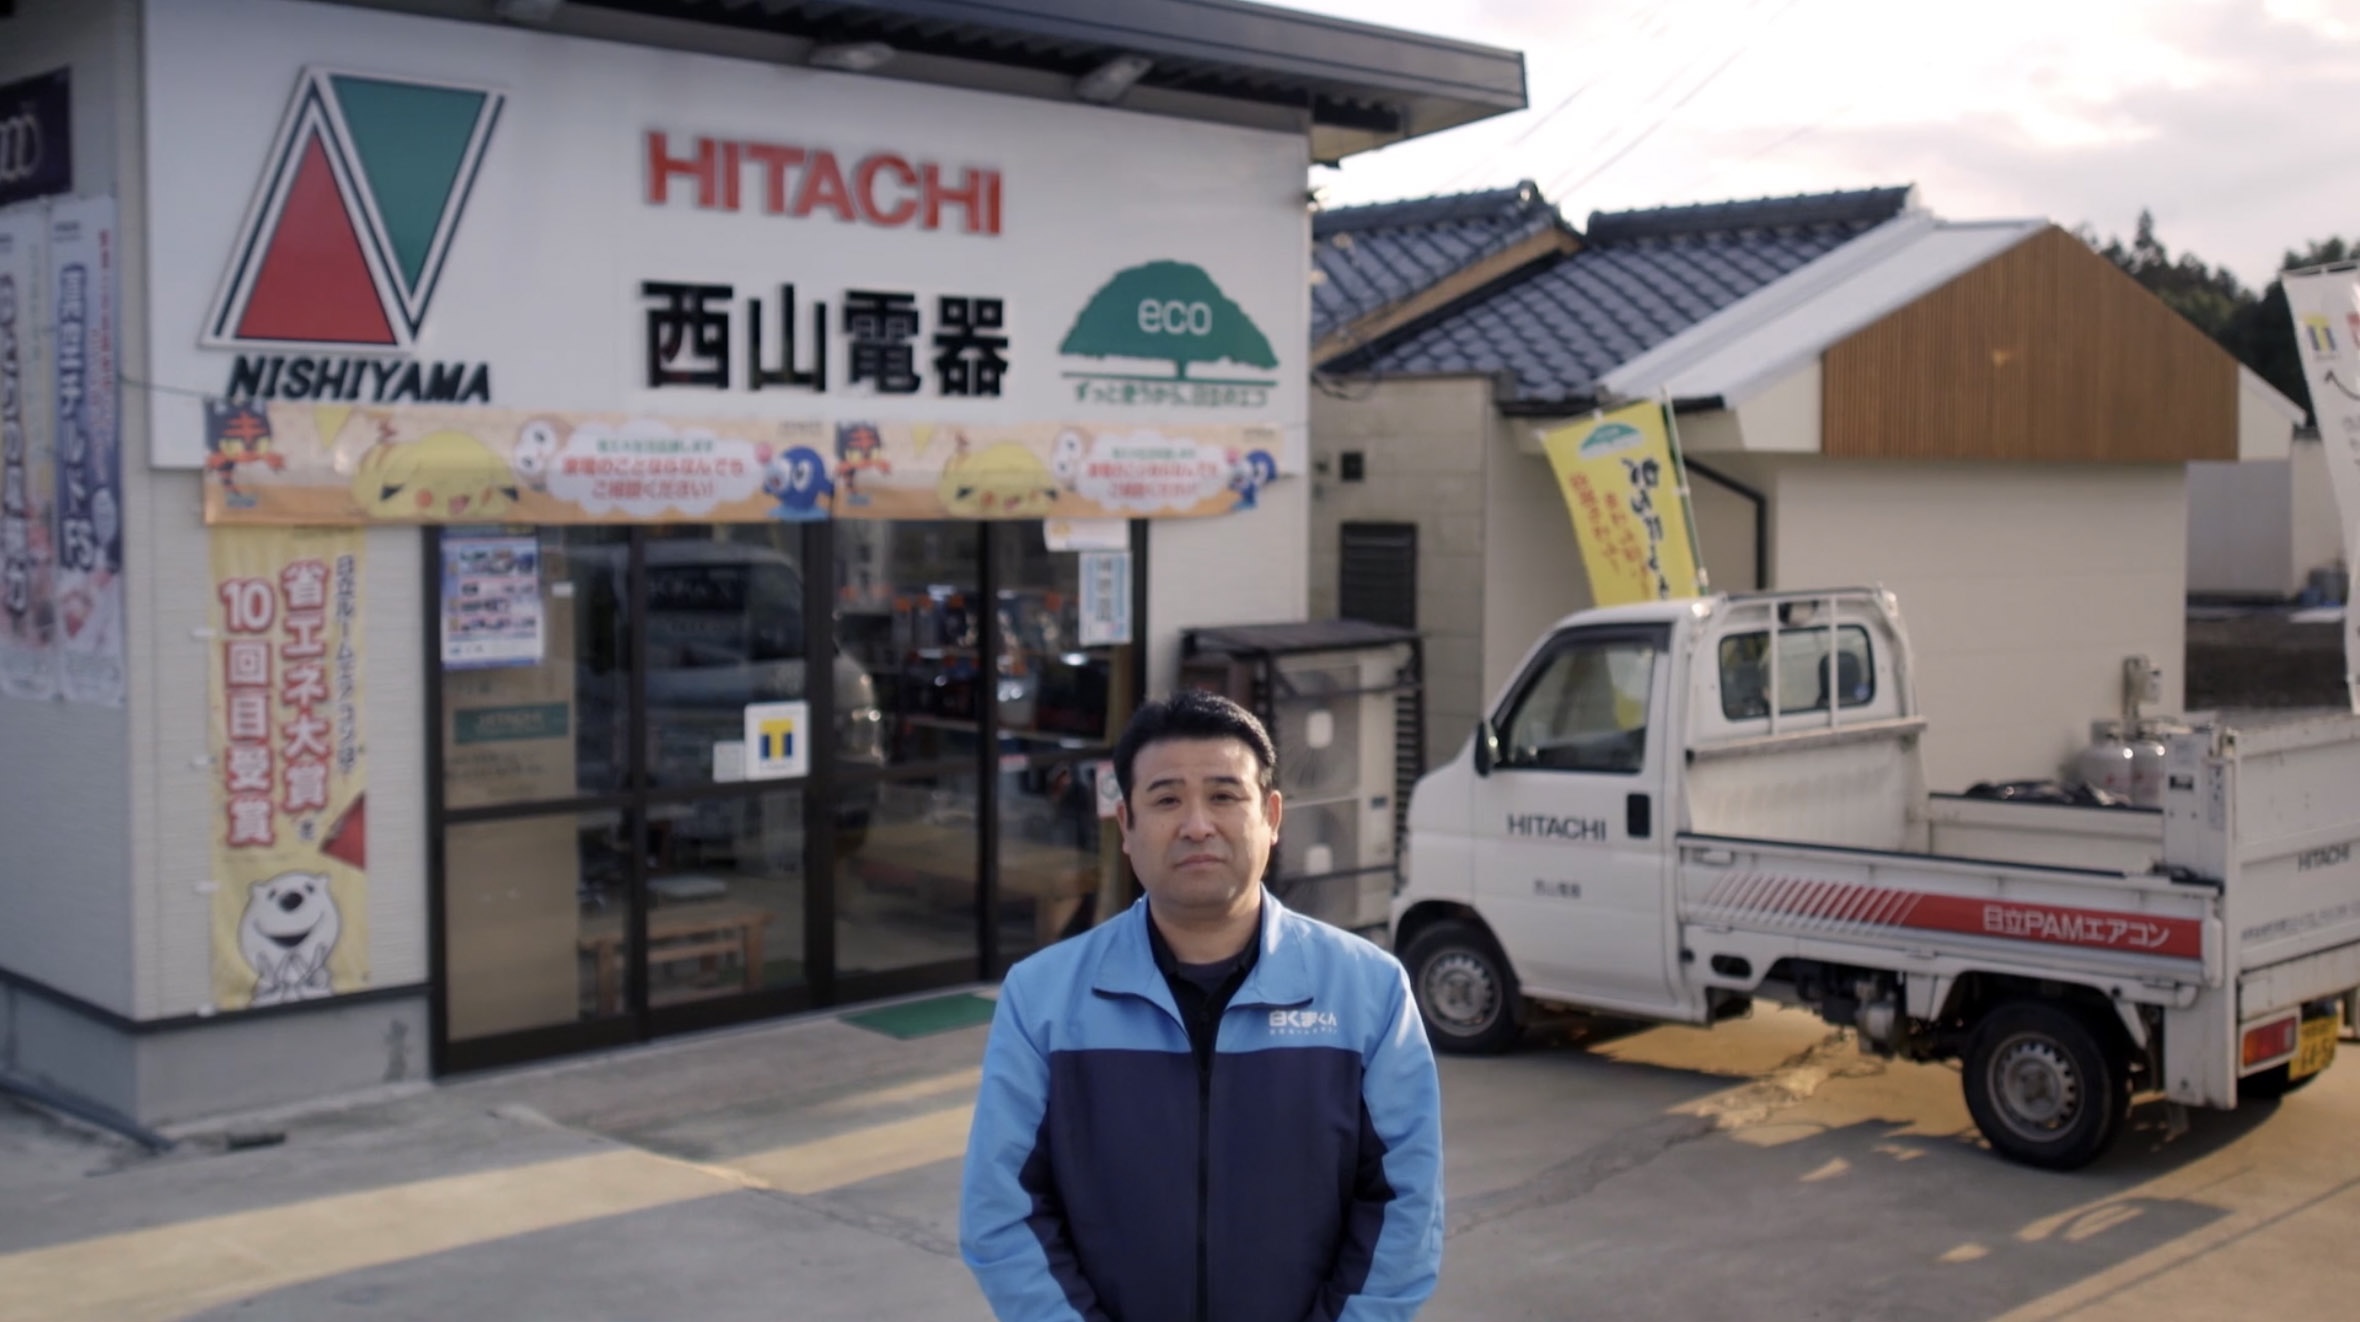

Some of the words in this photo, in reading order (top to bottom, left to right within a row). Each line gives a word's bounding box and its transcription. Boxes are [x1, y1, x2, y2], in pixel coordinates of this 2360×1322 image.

[645, 130, 1002, 237] HITACHI
[640, 280, 1010, 397] 西山電器
[1137, 298, 1213, 336] eco
[227, 355, 491, 403] NISHIYAMA
[220, 578, 275, 847] 10回目受賞
[1507, 813, 1607, 842] HITACHI
[2297, 842, 2351, 873] HITACHI
[1981, 905, 2171, 949] 日立PAMエアコン
